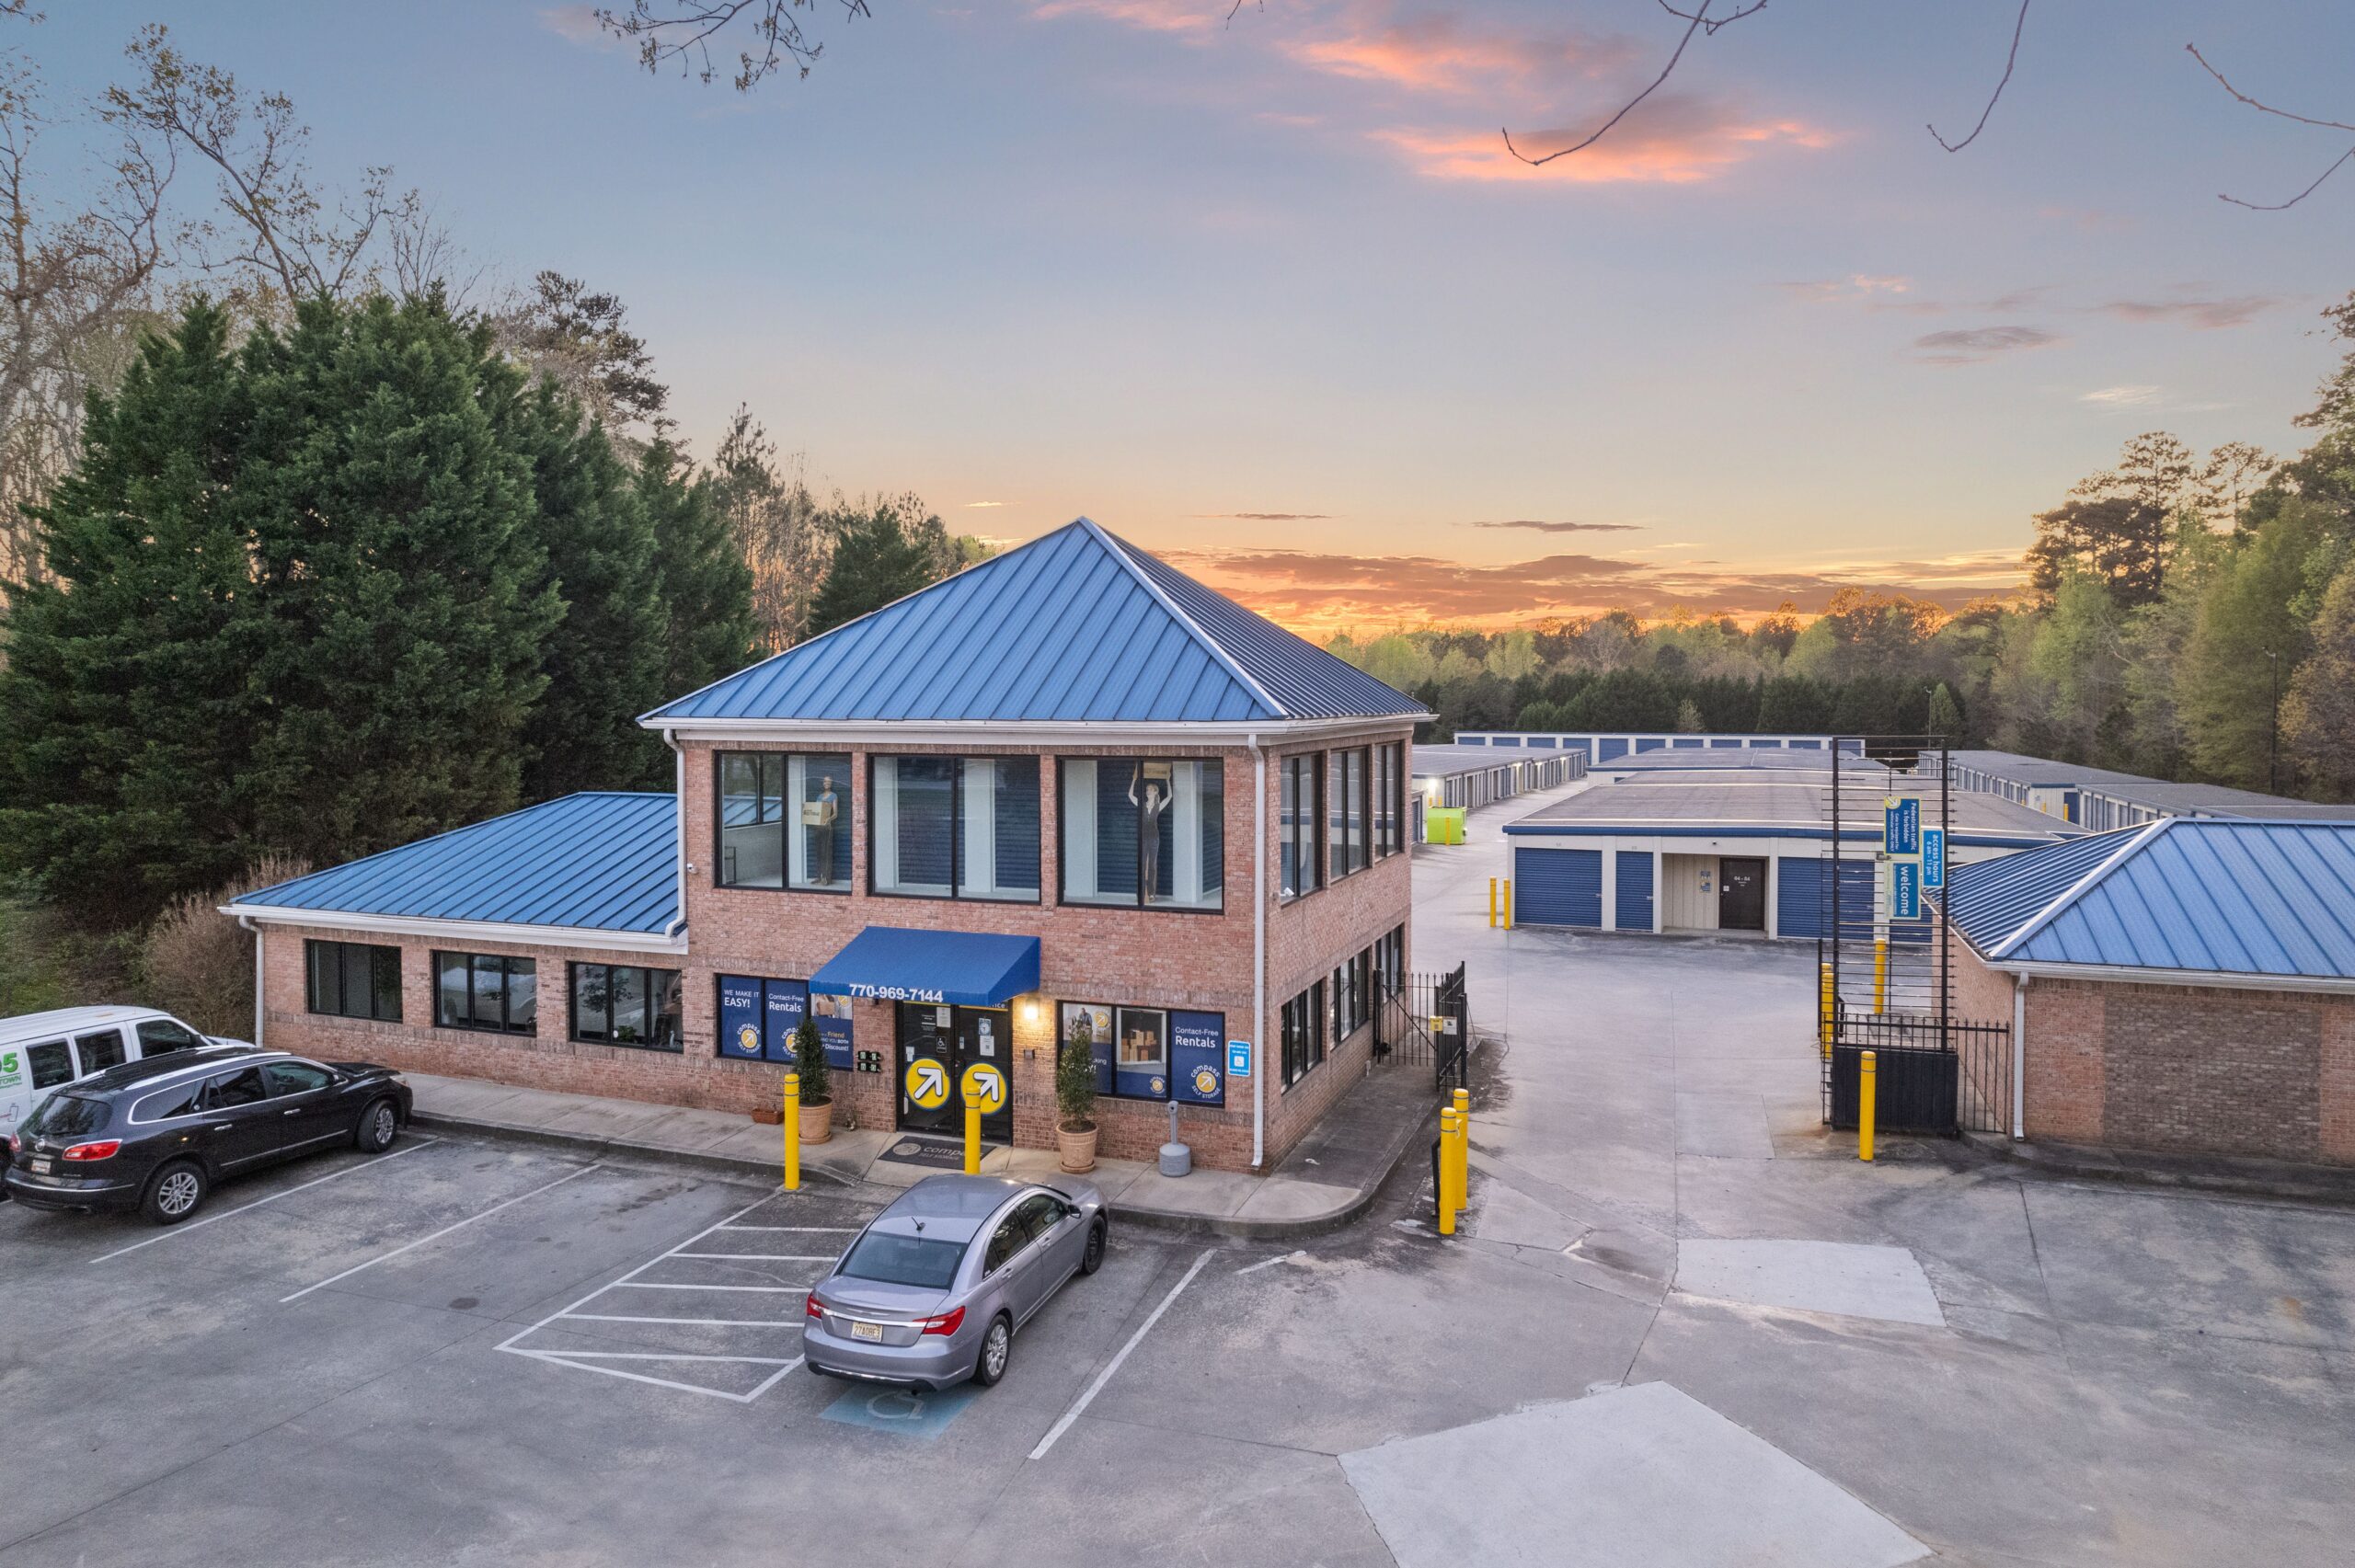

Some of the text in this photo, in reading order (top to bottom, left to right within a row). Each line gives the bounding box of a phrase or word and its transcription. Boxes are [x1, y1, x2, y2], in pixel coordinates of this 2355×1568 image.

[1932, 861, 1940, 883] hours
[1901, 865, 1912, 916] welcome
[768, 993, 805, 1002] Contact-Free
[849, 983, 944, 1003] 770-969-7144
[724, 997, 751, 1008] EASY!
[769, 1001, 802, 1013] Rentals
[737, 1023, 761, 1035] compass
[1175, 1026, 1219, 1036] Contact-Free
[1175, 1036, 1216, 1048] Rentals
[1190, 1064, 1220, 1078] compass
[1191, 1085, 1222, 1099] SELF STORAGE
